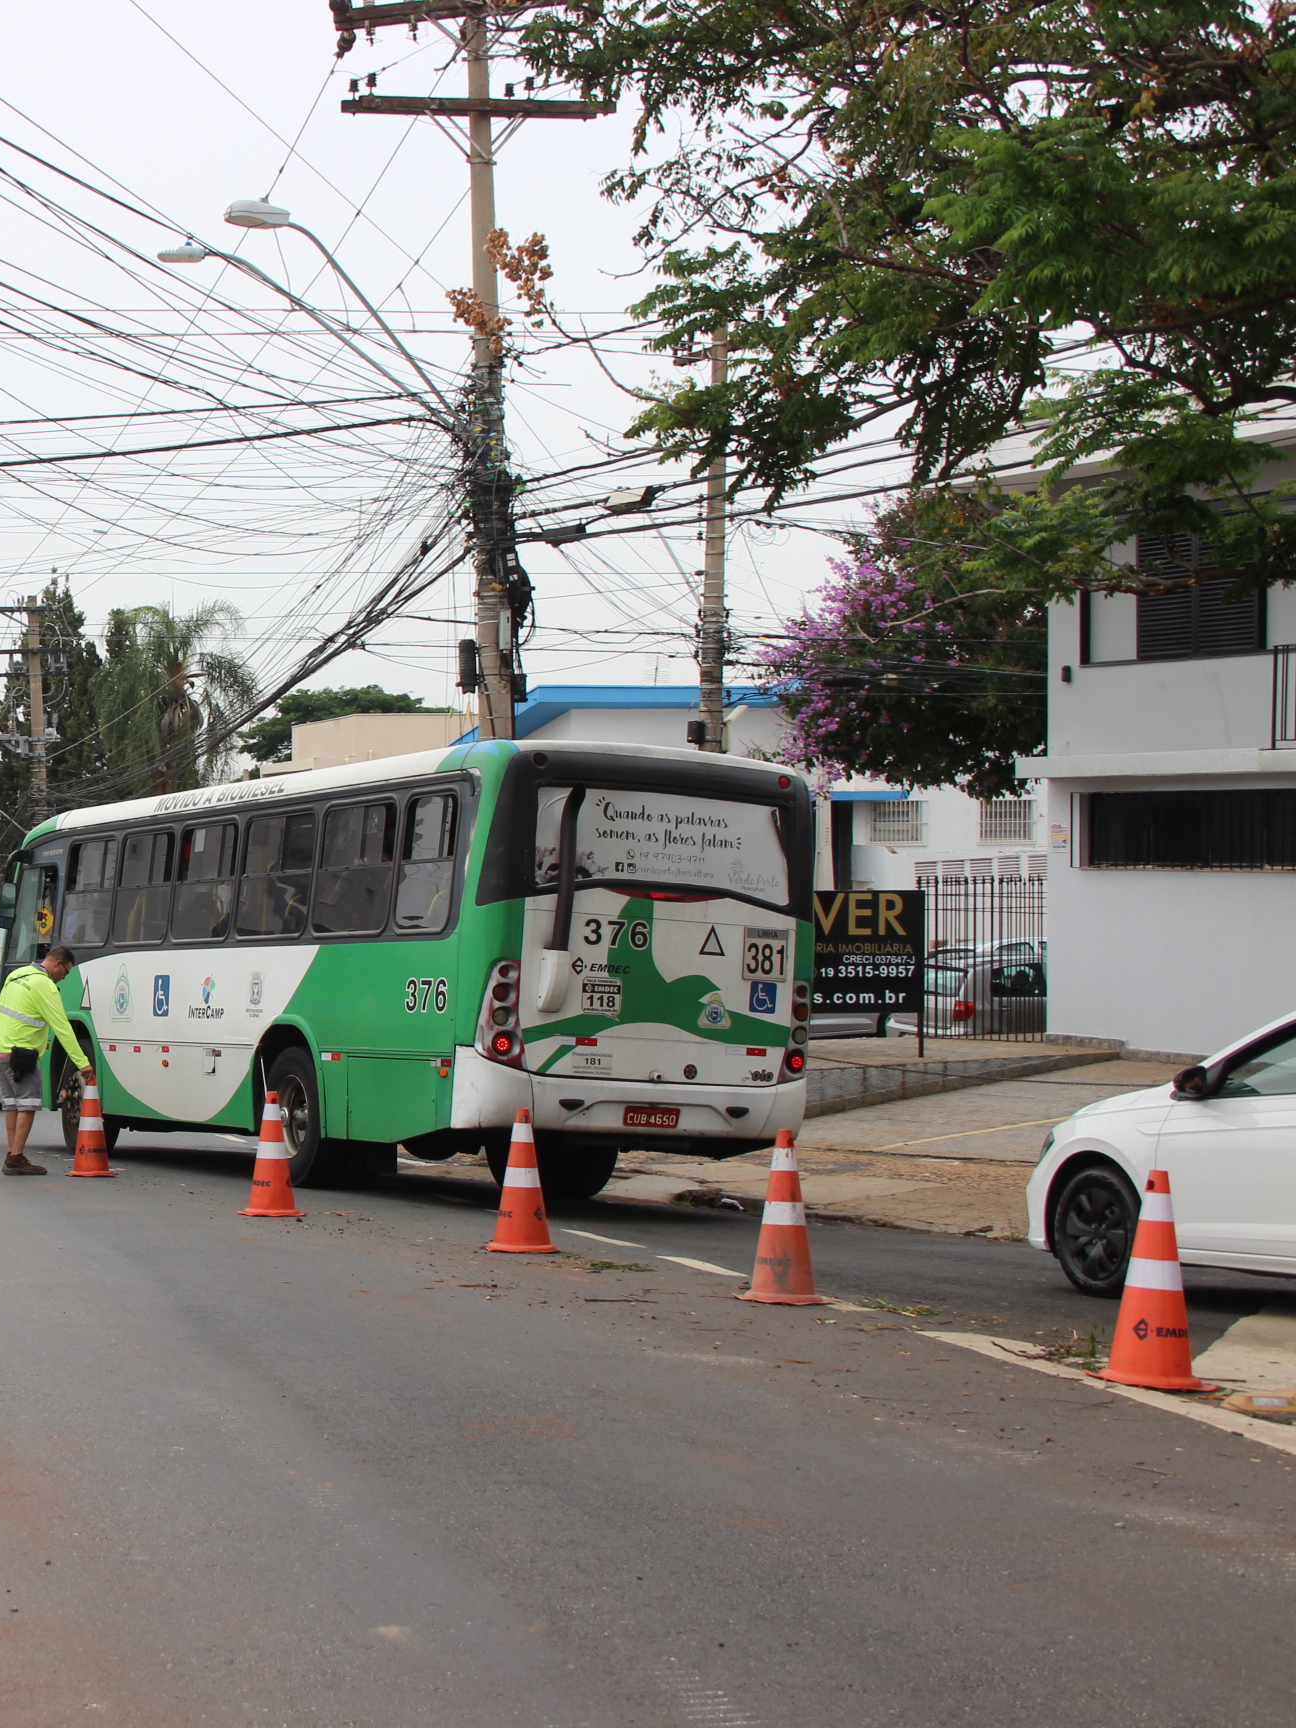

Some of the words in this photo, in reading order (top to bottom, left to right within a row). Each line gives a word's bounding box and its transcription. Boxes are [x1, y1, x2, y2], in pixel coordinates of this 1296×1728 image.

[153, 792, 204, 813] MOVIDO
[203, 791, 214, 805] A
[215, 777, 289, 803] BIODIESEL
[602, 801, 654, 823] Quando
[656, 813, 672, 824] as
[674, 811, 729, 830] palavras
[595, 826, 641, 844] somem,
[644, 831, 659, 844] as
[663, 828, 698, 850] flores
[699, 832, 735, 853] falam
[638, 851, 650, 861] 19
[583, 918, 650, 950] 376
[757, 930, 779, 939] LINHA
[814, 942, 836, 954] RIA
[838, 941, 914, 954] IMOBILIÁRIA
[746, 942, 786, 976] 381
[842, 954, 873, 964] CRECI
[874, 955, 916, 965] 037647-J
[589, 962, 632, 975] EMDEC
[819, 967, 835, 978] 19
[837, 965, 916, 978] 3515-9957
[404, 976, 449, 1015] 376
[594, 985, 619, 993] EMDEC
[586, 994, 616, 1009] 118
[812, 989, 907, 1004] s.com.br
[584, 1057, 601, 1066] 181
